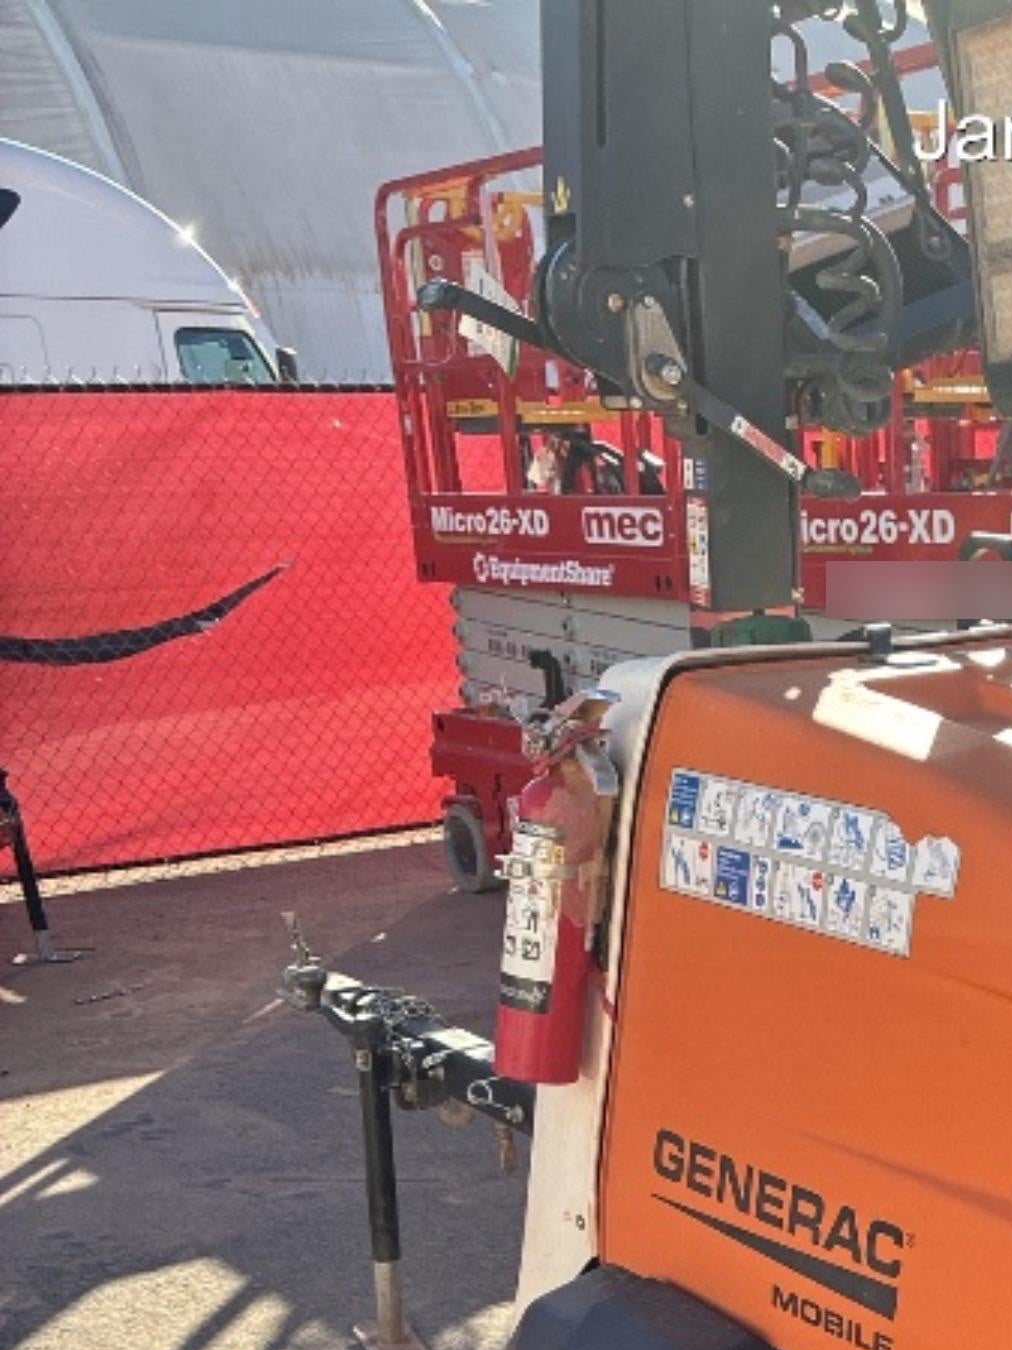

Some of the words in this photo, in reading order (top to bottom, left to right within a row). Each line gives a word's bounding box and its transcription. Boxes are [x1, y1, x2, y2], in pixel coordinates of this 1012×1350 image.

[430, 506, 549, 537] Micro26-XD
[585, 510, 662, 542] mec
[801, 509, 955, 545] icro26-XD
[653, 1128, 904, 1279] GENERAC
